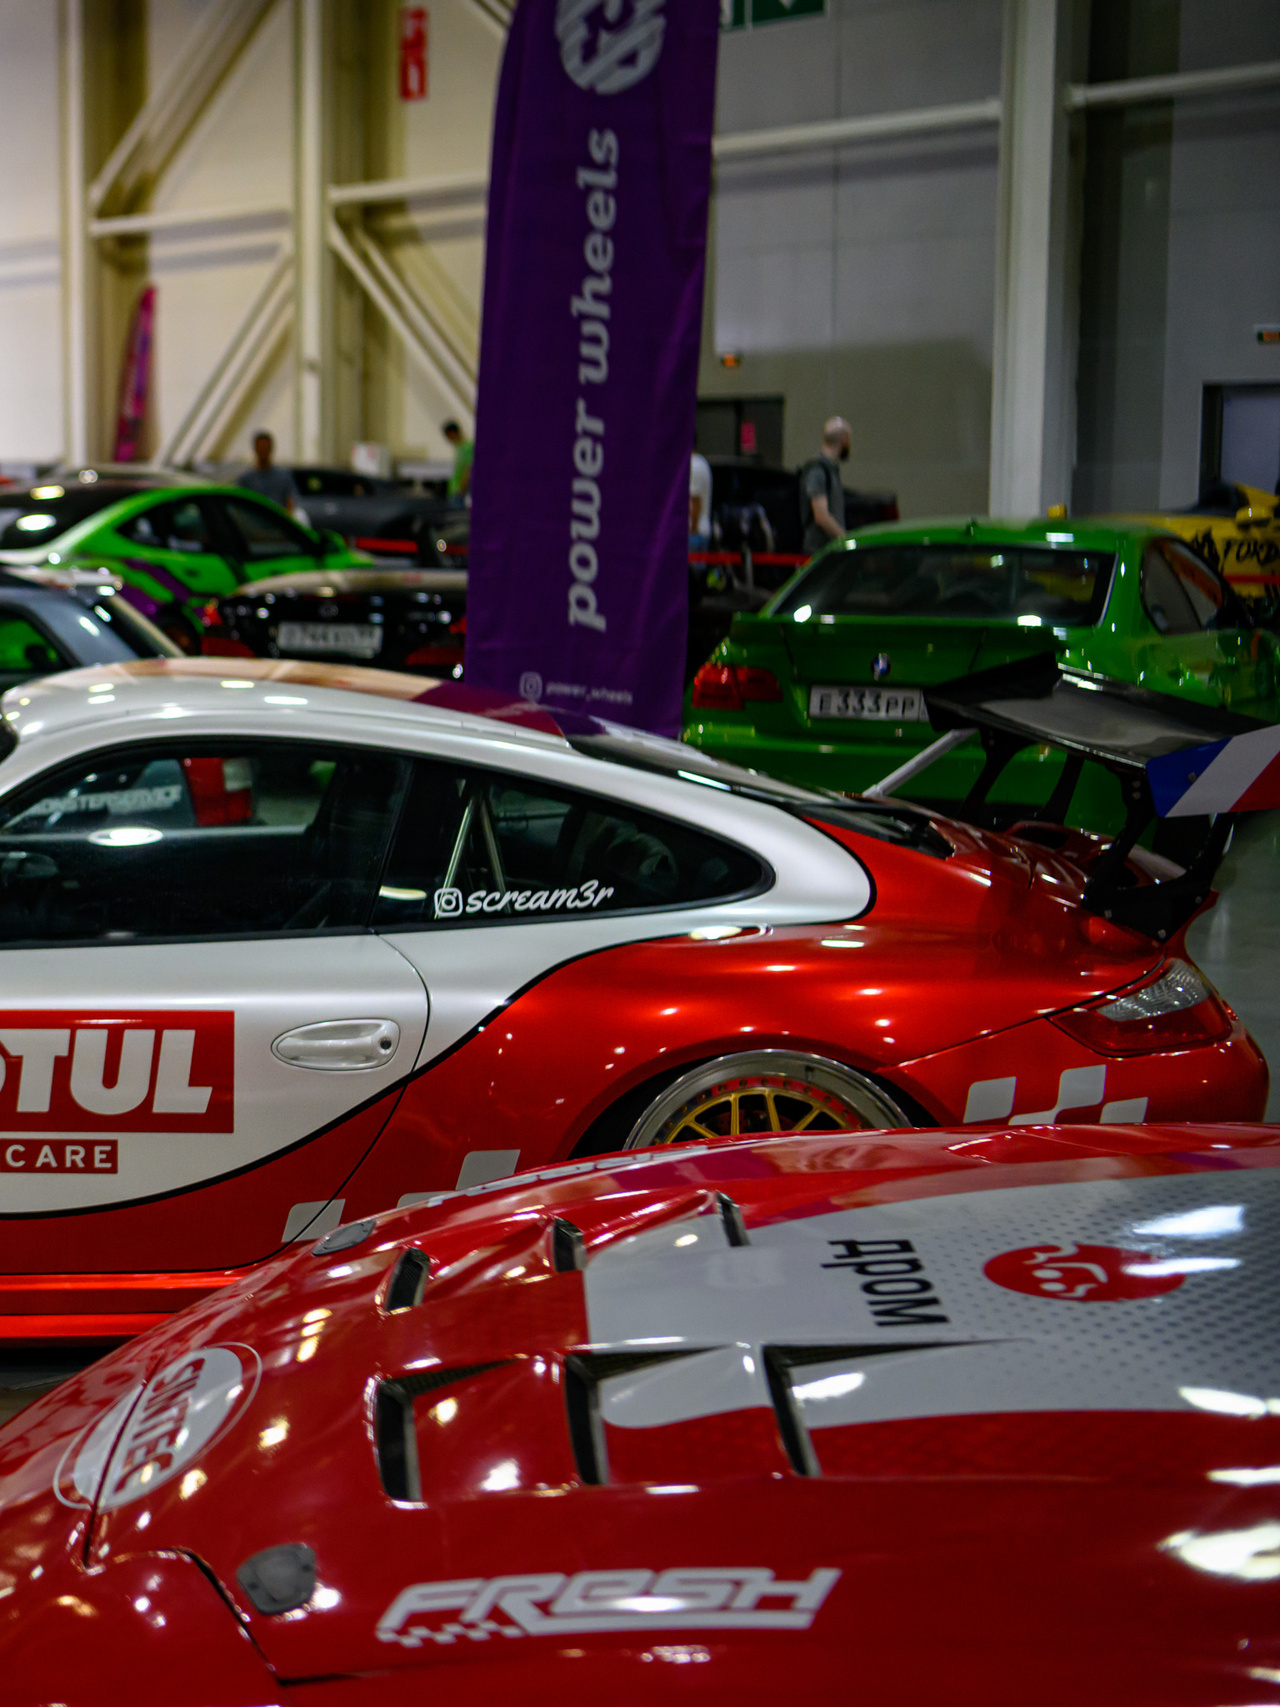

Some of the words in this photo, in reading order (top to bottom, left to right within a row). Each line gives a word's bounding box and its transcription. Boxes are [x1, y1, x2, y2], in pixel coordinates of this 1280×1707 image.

[570, 127, 620, 386] wheels
[567, 397, 606, 632] power
[465, 879, 615, 914] scream3r
[112, 1357, 207, 1495] SINTEC
[375, 1567, 843, 1640] FRESH
